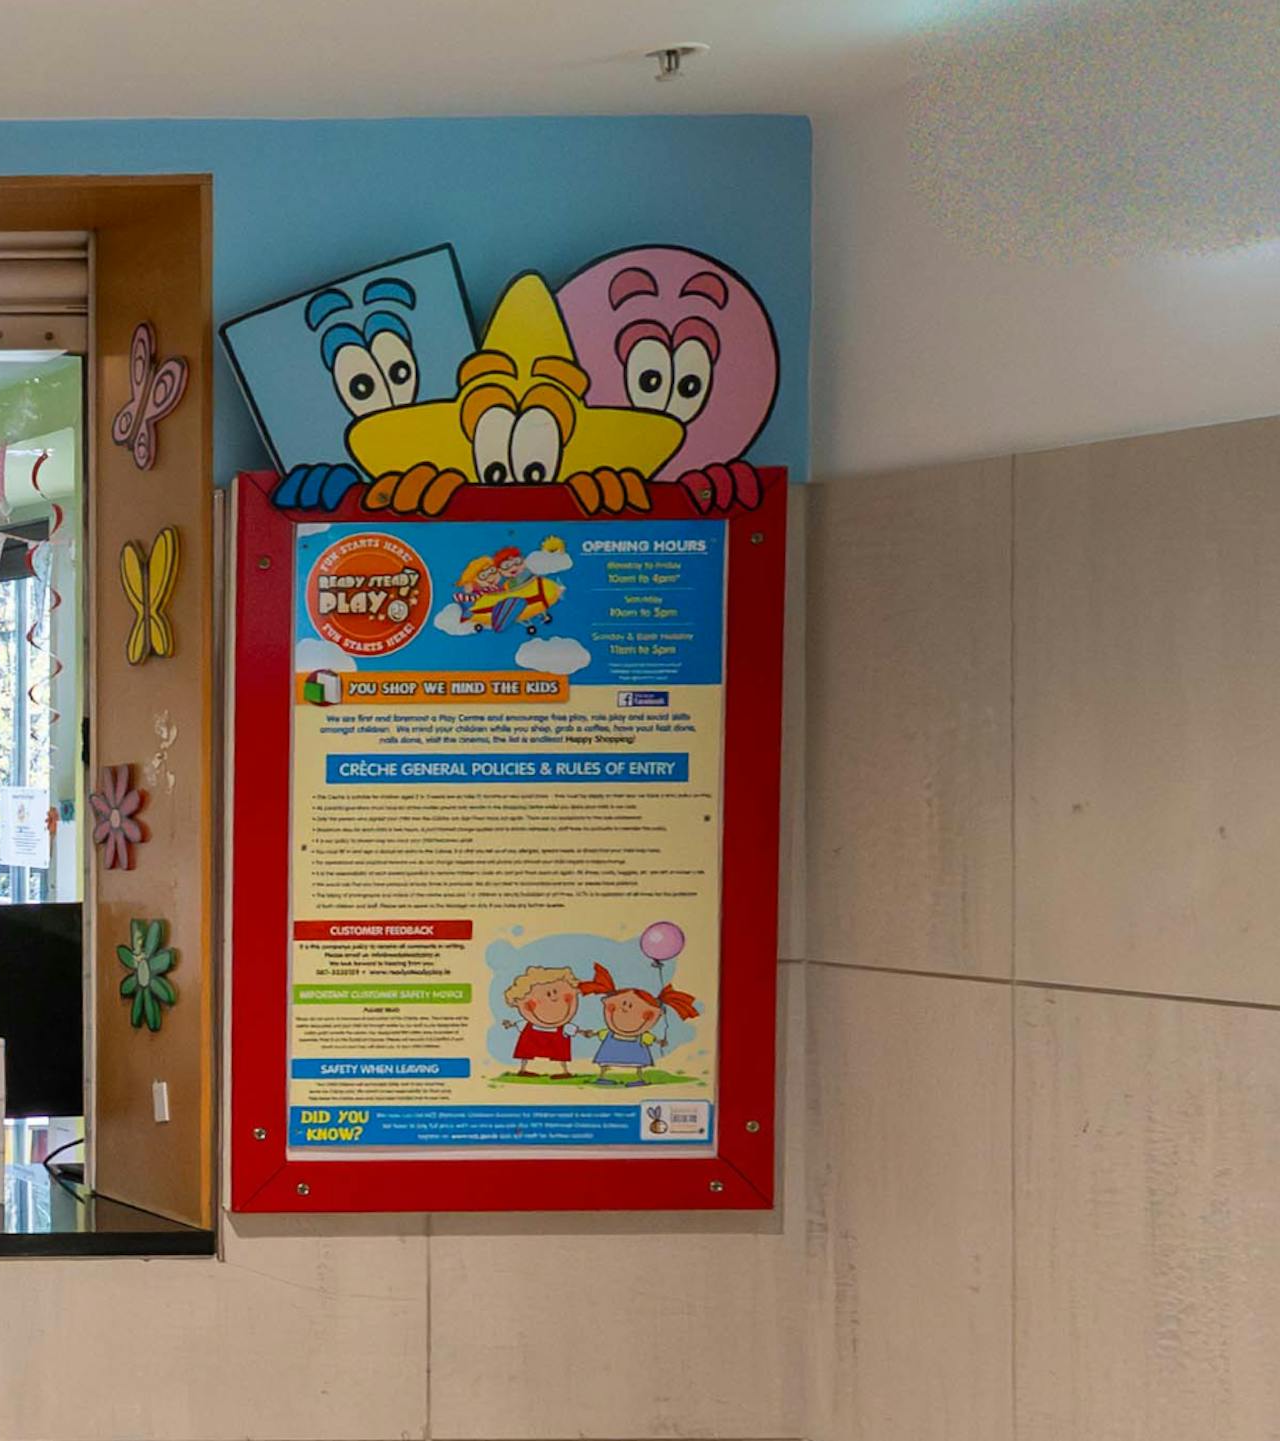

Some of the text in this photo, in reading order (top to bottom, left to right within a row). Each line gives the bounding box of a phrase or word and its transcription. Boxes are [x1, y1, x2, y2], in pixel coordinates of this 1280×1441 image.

[582, 540, 706, 553] OPENING HOURS
[319, 575, 365, 589] READY
[319, 590, 388, 613] PLAY
[348, 681, 559, 695] YOU SHOP WE MIND THE KIDS
[339, 759, 676, 777] CRÈCHE GENERAL POLICIES & RULES OF ENTRY
[330, 925, 434, 936] CUSTOMER FEEDBACK
[320, 1064, 439, 1074] SAFETY WHEN LEAVING
[300, 1111, 370, 1124] DID YOU
[306, 1127, 363, 1141] KNOW?
